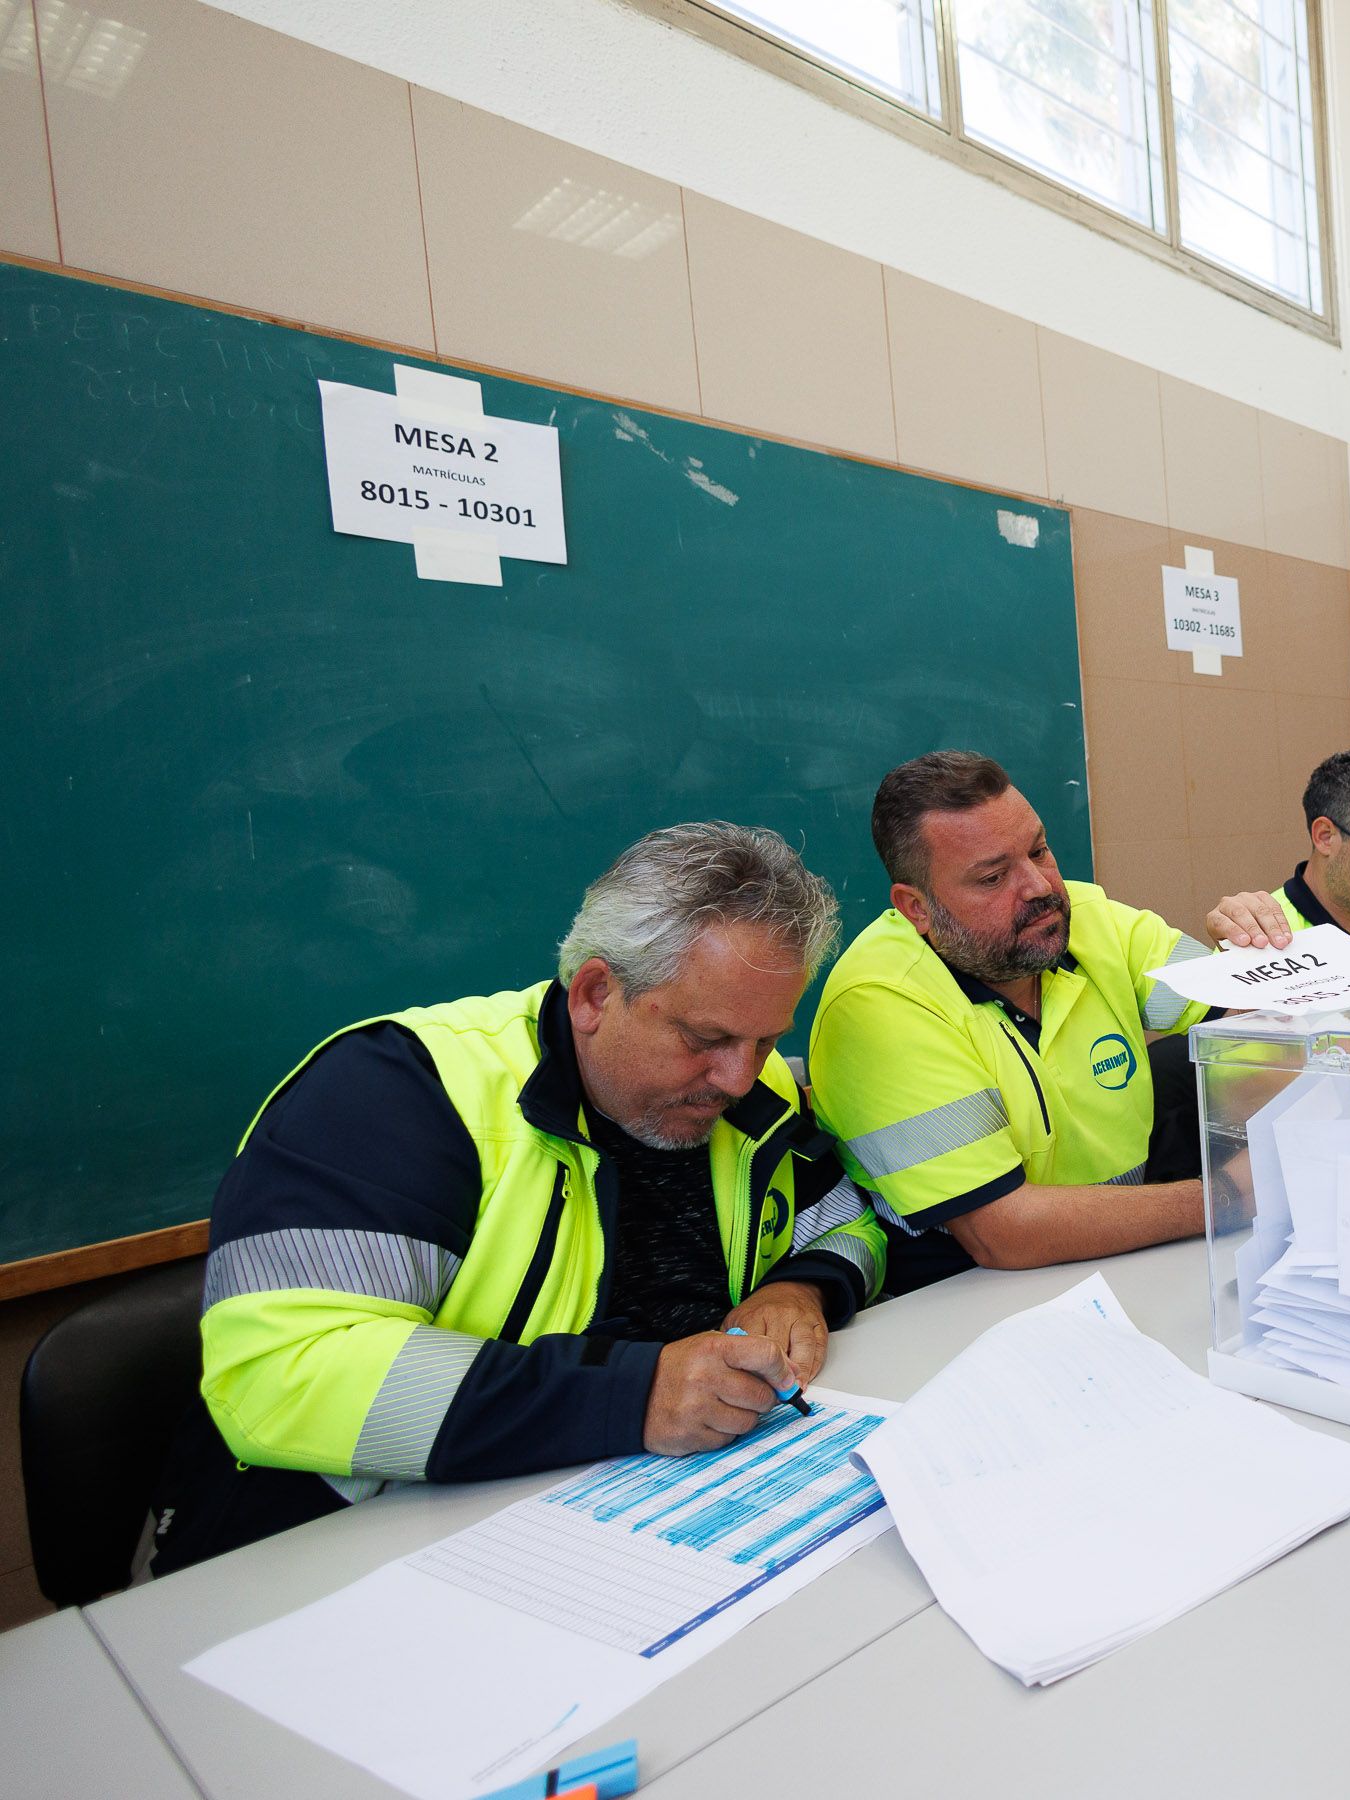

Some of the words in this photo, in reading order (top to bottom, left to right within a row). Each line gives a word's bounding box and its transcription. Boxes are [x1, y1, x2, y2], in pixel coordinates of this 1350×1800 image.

[394, 423, 476, 459] MESA
[483, 442, 500, 463] 2
[412, 464, 487, 487] MATRÍCULAS
[360, 480, 430, 510] 8015
[457, 498, 537, 528] 10301
[1185, 585, 1212, 601] MESA
[1213, 590, 1220, 602] 3
[1173, 618, 1201, 633] 10302
[1209, 623, 1236, 638] 11685
[1231, 957, 1310, 986] MESA
[1301, 952, 1328, 968] 2
[1091, 1050, 1128, 1077] ACERINOX
